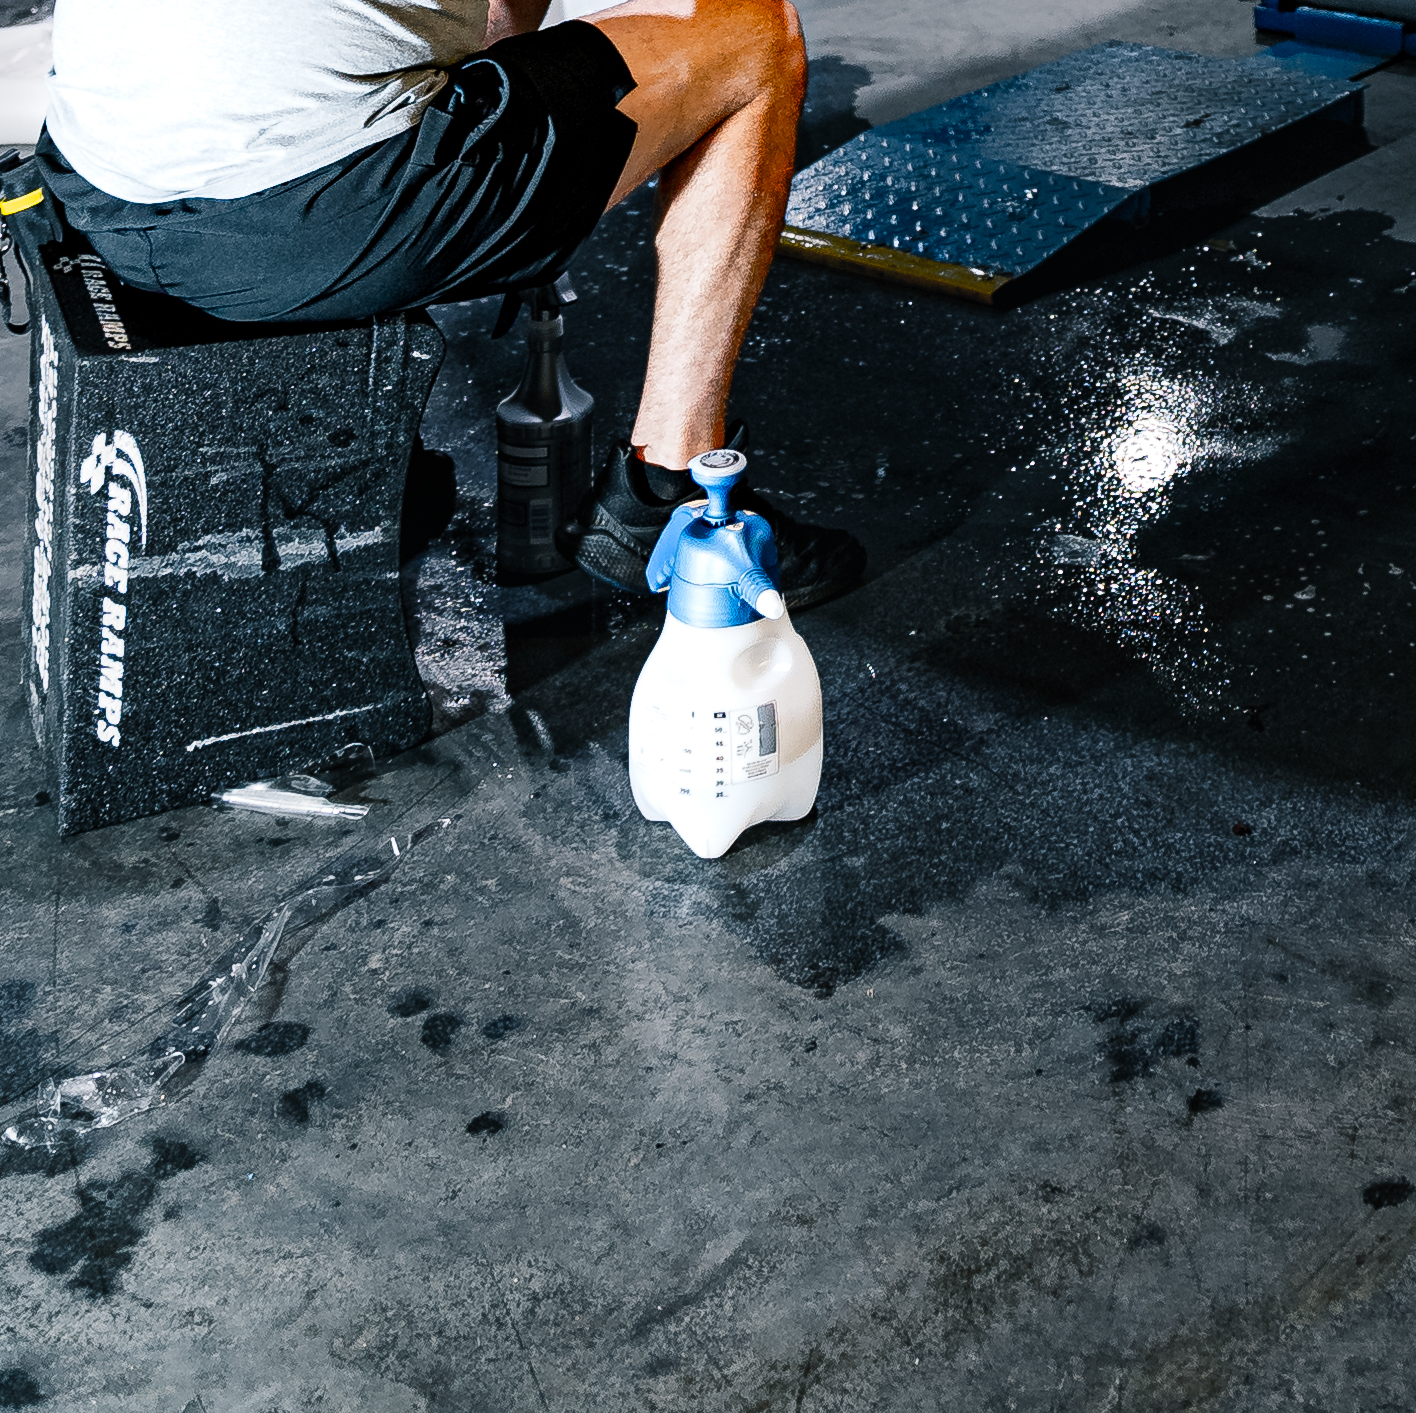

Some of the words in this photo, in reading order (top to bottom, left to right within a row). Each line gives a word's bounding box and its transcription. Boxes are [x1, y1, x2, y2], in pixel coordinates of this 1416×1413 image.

[80, 269, 114, 301] RACE
[93, 302, 132, 350] RAMPS
[103, 481, 132, 594] RACE
[97, 597, 127, 749] RAMPS
